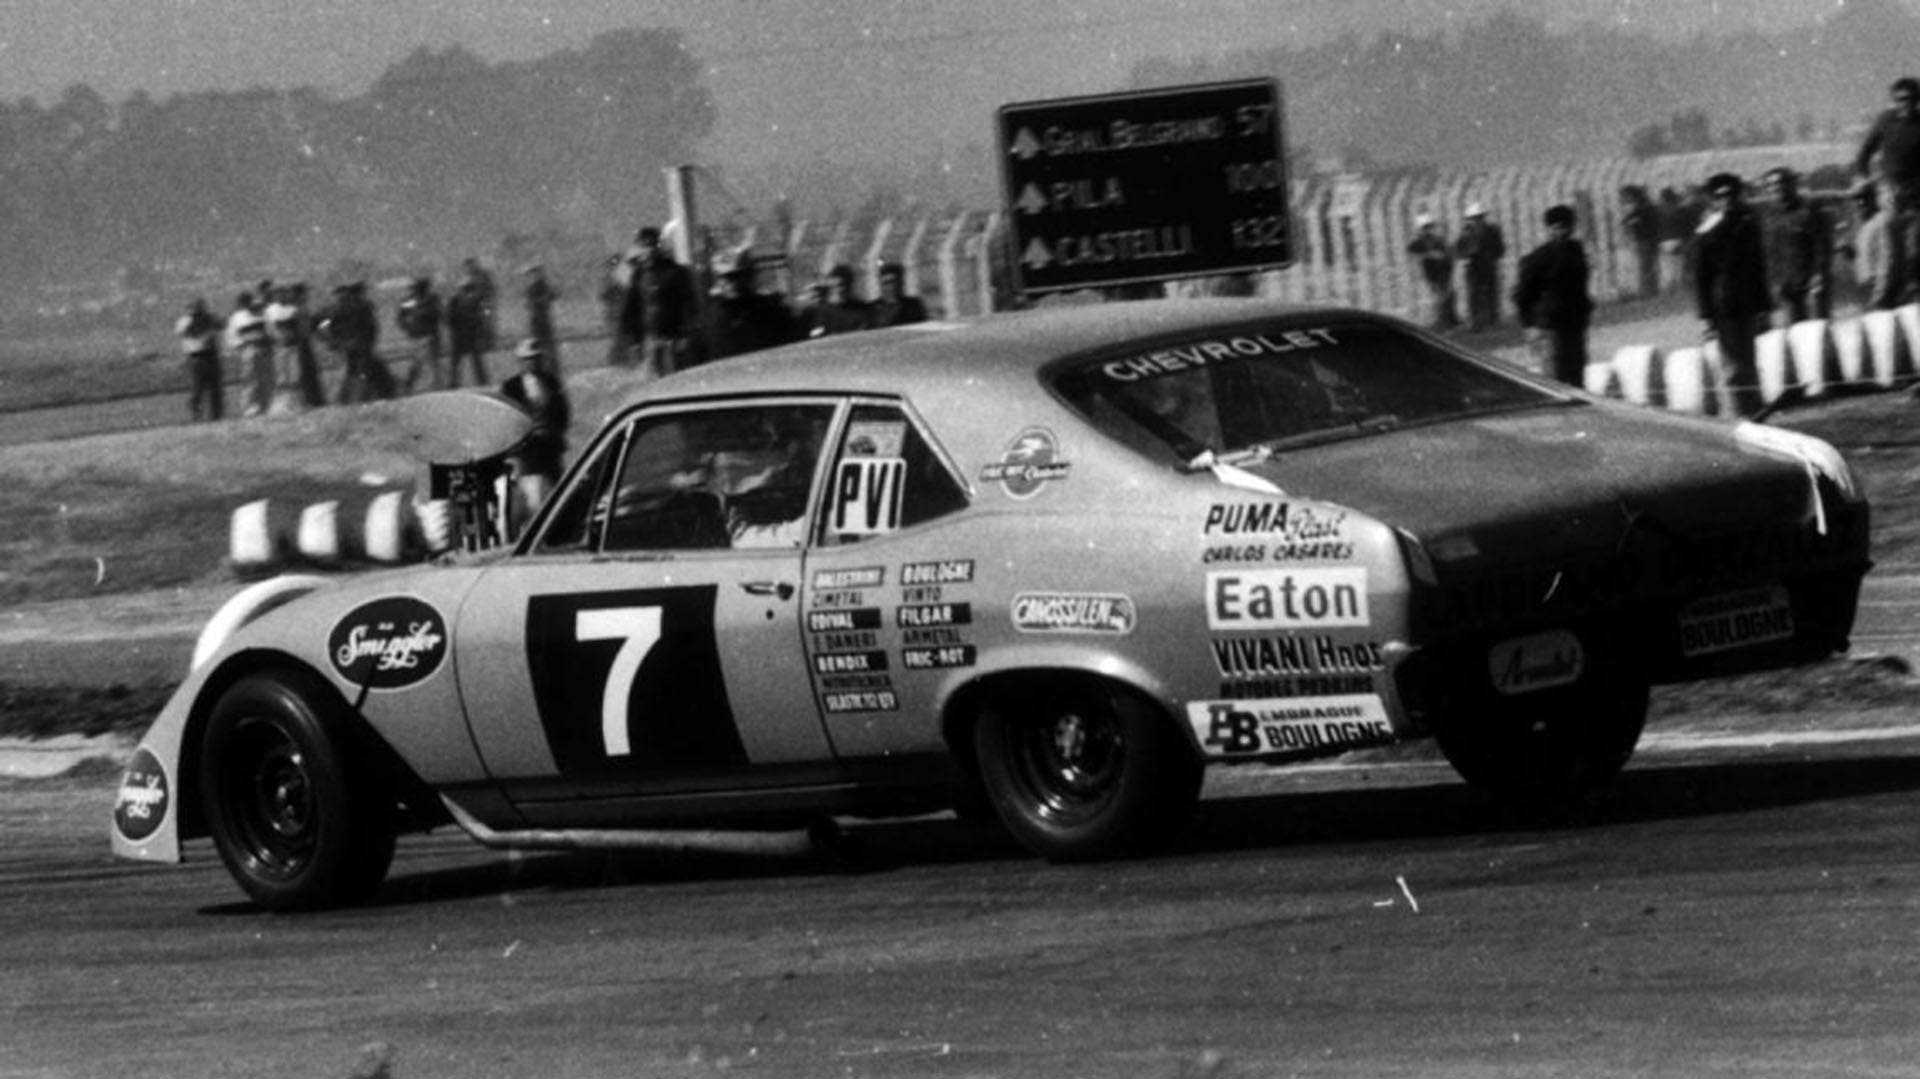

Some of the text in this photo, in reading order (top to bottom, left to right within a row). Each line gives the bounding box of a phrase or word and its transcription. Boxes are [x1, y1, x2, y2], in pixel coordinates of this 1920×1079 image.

[1235, 103, 1276, 137] 57
[1224, 158, 1284, 192] 100
[1055, 224, 1194, 267] CASTELLI
[1103, 328, 1339, 383] CHEVROLET
[1204, 503, 1289, 535] PUMA
[1203, 543, 1354, 564] CARLOS CASARES
[903, 562, 971, 583] BOULOGNE
[900, 605, 953, 625] FILGAR
[1216, 576, 1358, 620] Eaton
[337, 620, 442, 671] Smuggler
[1686, 609, 1793, 650] BOULOGNE
[817, 654, 870, 673] BENDIX
[905, 648, 965, 668] FRIC-ROT
[1211, 634, 1386, 677] VIVANI Hnos
[575, 605, 663, 756] 7
[1259, 706, 1364, 722] EMBRAGUE
[1264, 721, 1390, 749] BOULOGNE
